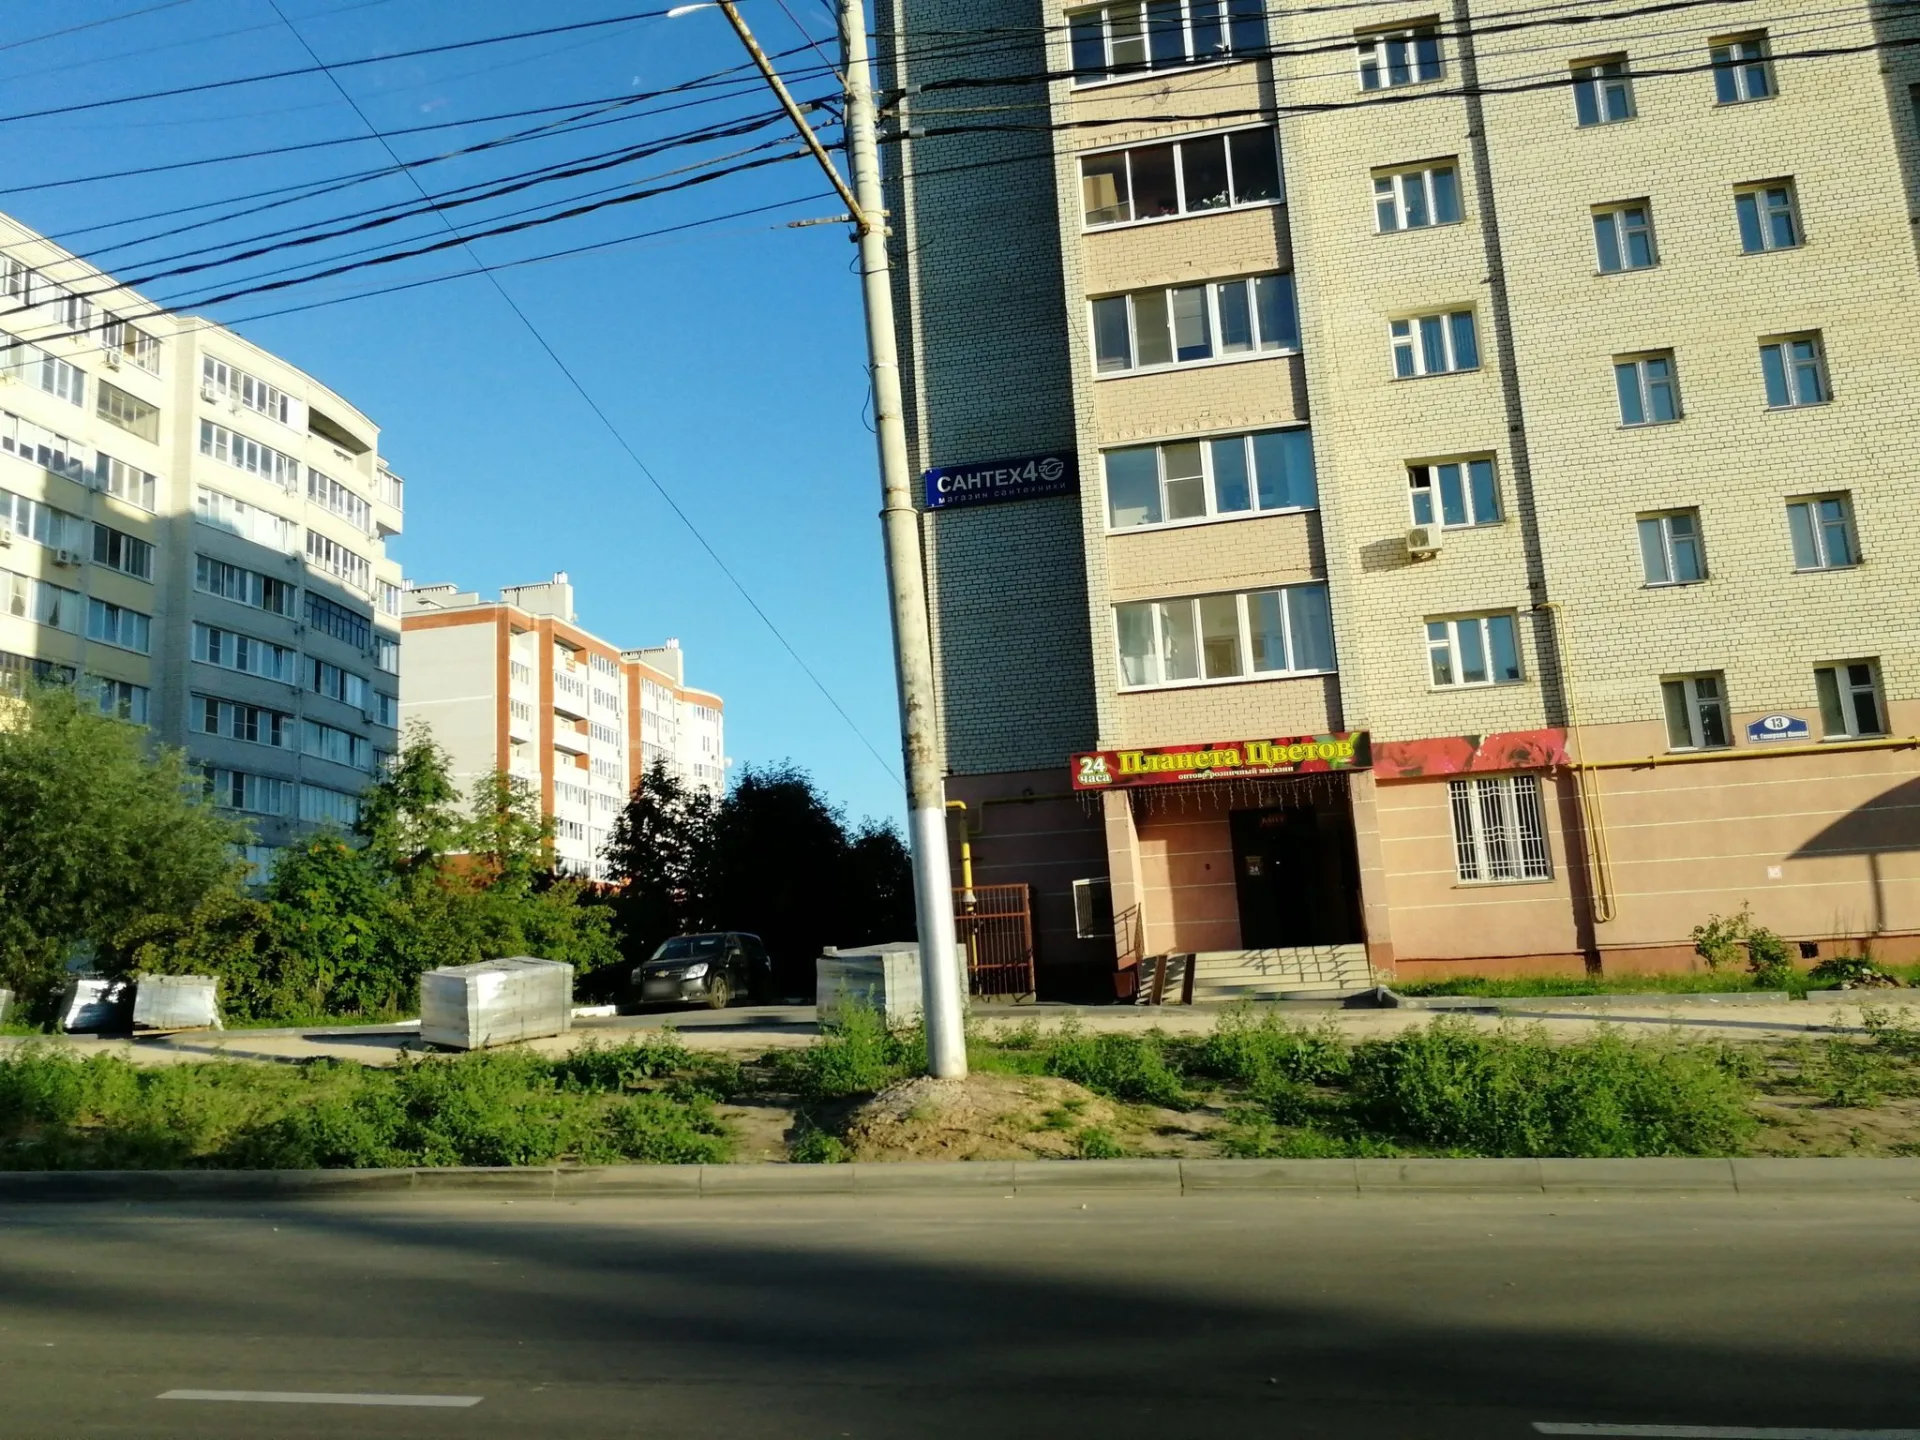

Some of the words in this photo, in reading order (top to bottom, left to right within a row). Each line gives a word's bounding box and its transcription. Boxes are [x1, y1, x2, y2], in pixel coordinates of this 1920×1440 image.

[938, 491, 988, 504] магазин
[994, 482, 1066, 497] сантехники
[1771, 717, 1784, 728] 13
[1117, 747, 1241, 774] Планета
[1244, 740, 1354, 767] Цветов
[1080, 756, 1106, 774] 24
[1259, 766, 1293, 774] магазин
[1079, 772, 1112, 784] часа
